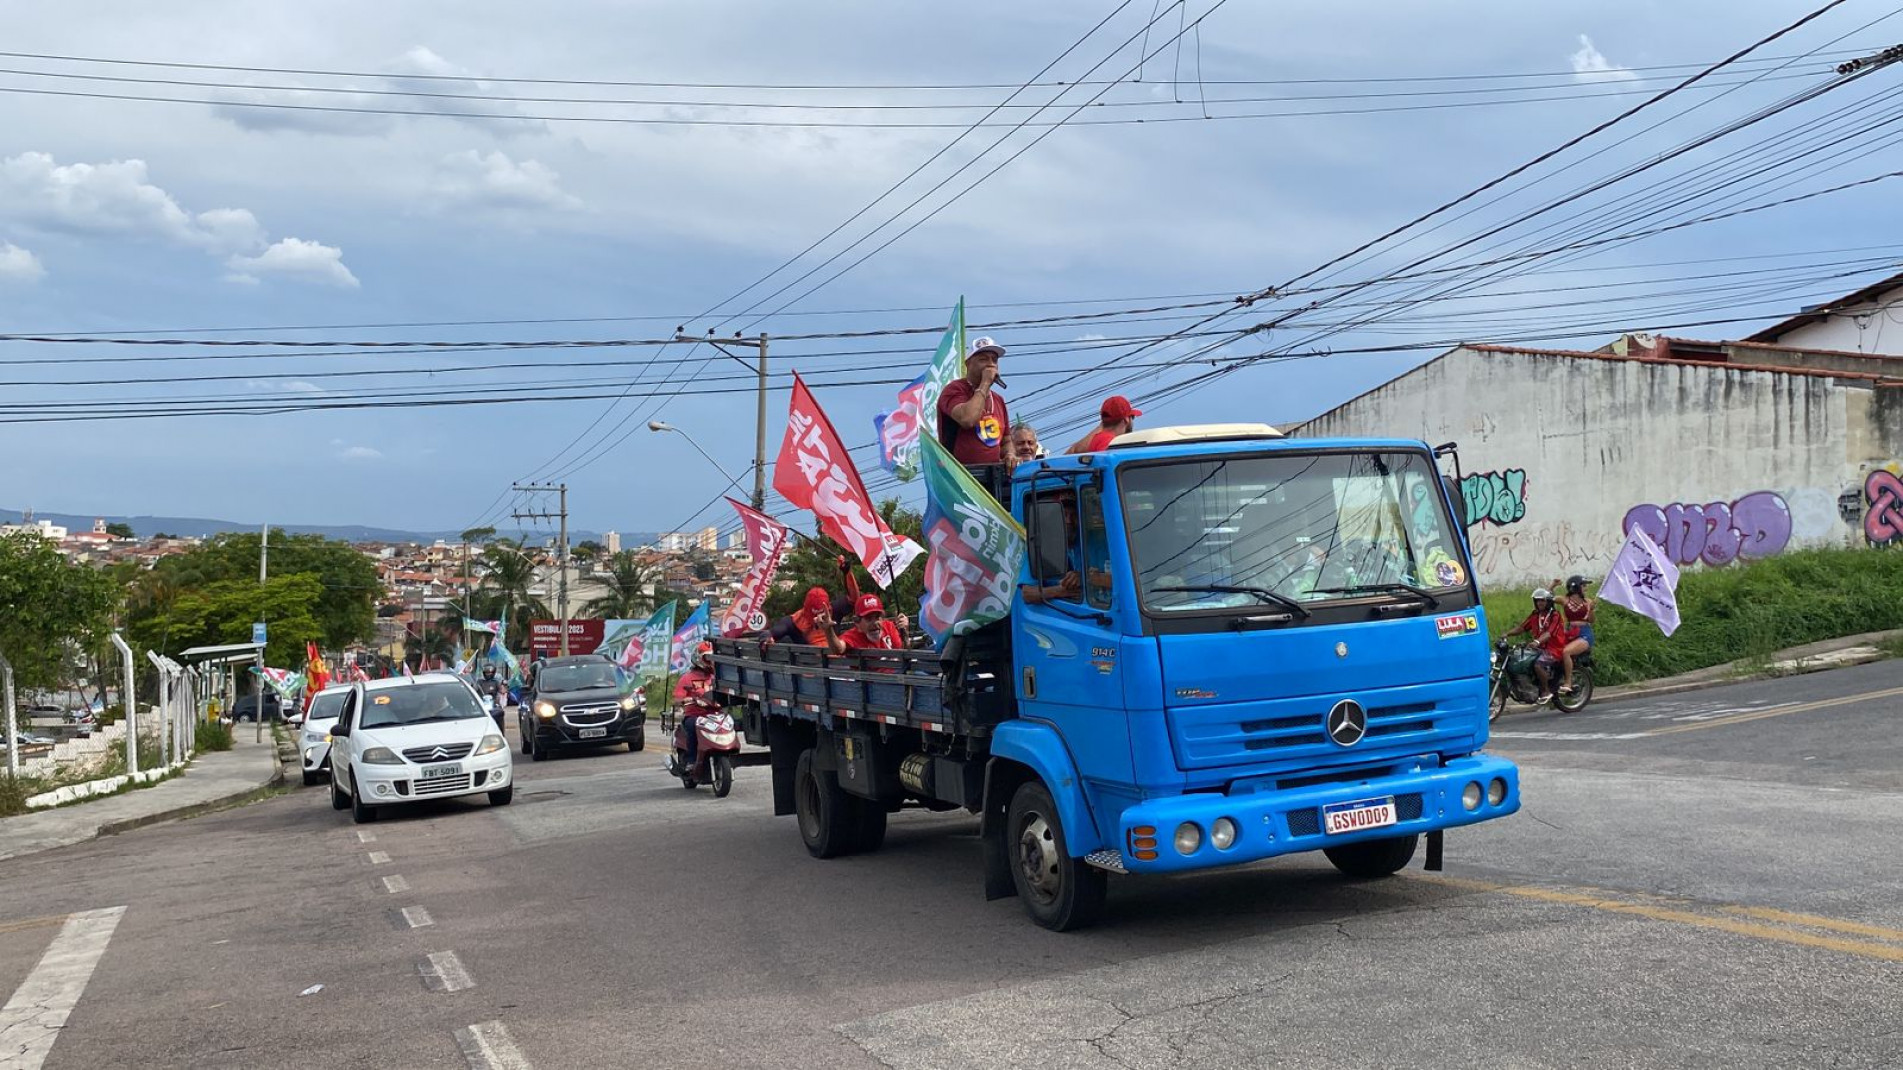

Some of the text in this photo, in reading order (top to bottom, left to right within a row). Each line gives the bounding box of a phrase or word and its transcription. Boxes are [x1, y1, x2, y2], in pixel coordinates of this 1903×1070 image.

[979, 417, 1000, 439] 13
[1640, 573, 1655, 583] PT
[1437, 617, 1463, 630] LULA
[1464, 616, 1477, 630] 13
[568, 624, 584, 634] 2023
[440, 767, 460, 776] 5091
